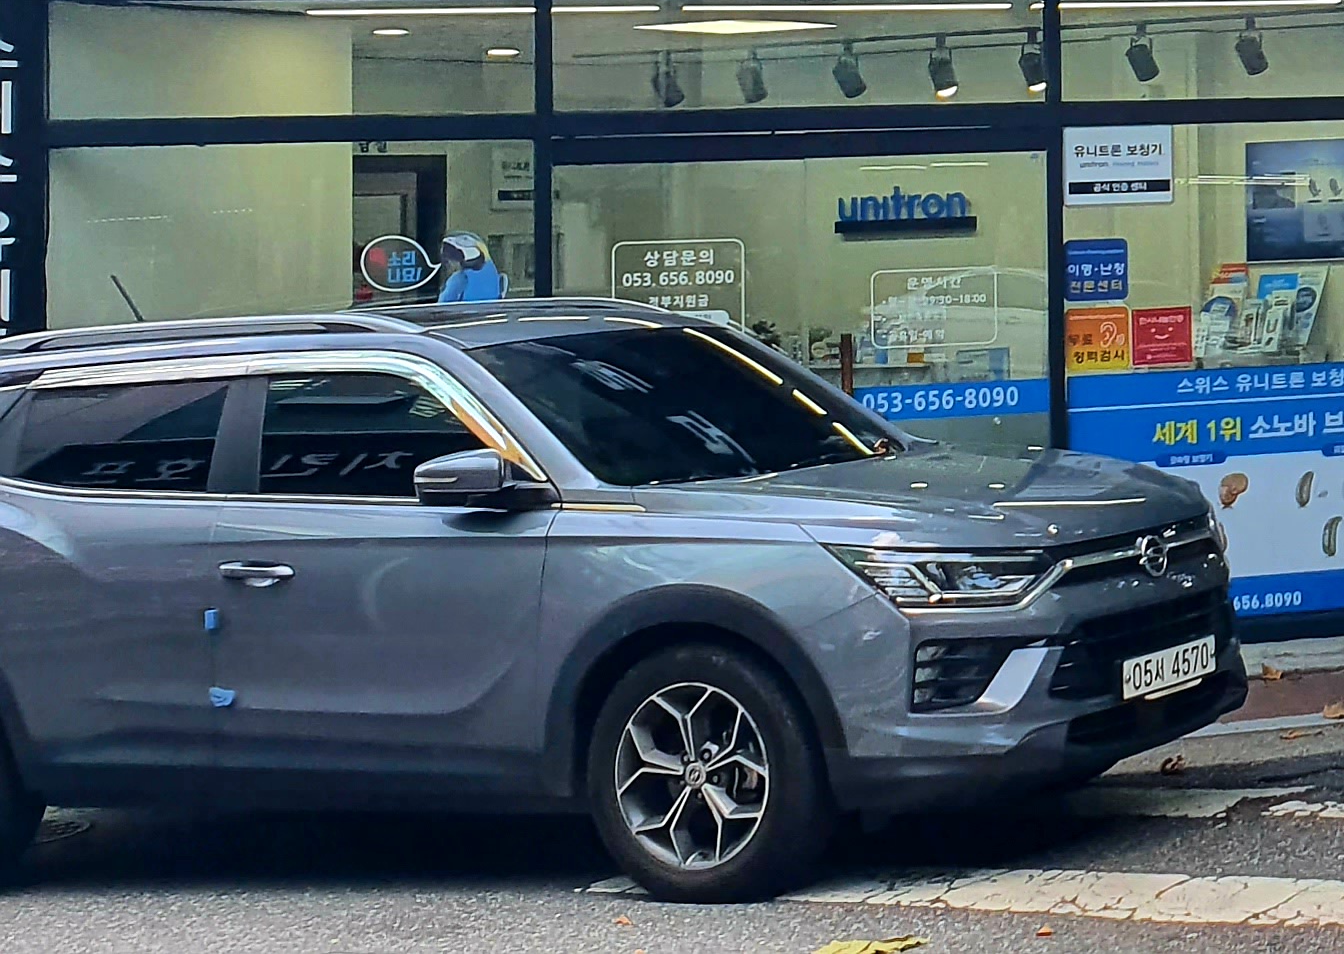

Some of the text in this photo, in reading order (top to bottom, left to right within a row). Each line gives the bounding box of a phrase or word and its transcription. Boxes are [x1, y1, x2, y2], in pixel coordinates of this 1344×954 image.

[1073, 142, 1163, 158] 유니트론 보청기
[837, 185, 968, 223] unitron
[643, 248, 715, 268] 상담문의
[1176, 376, 1230, 395] 스위스
[1235, 371, 1305, 393] 유니트론
[862, 385, 1020, 413] 053-656-8090
[1152, 418, 1198, 446] 세계
[1206, 415, 1242, 442] 1위
[1248, 410, 1316, 440] 소노바
[1132, 642, 1210, 691] 05서 4570
